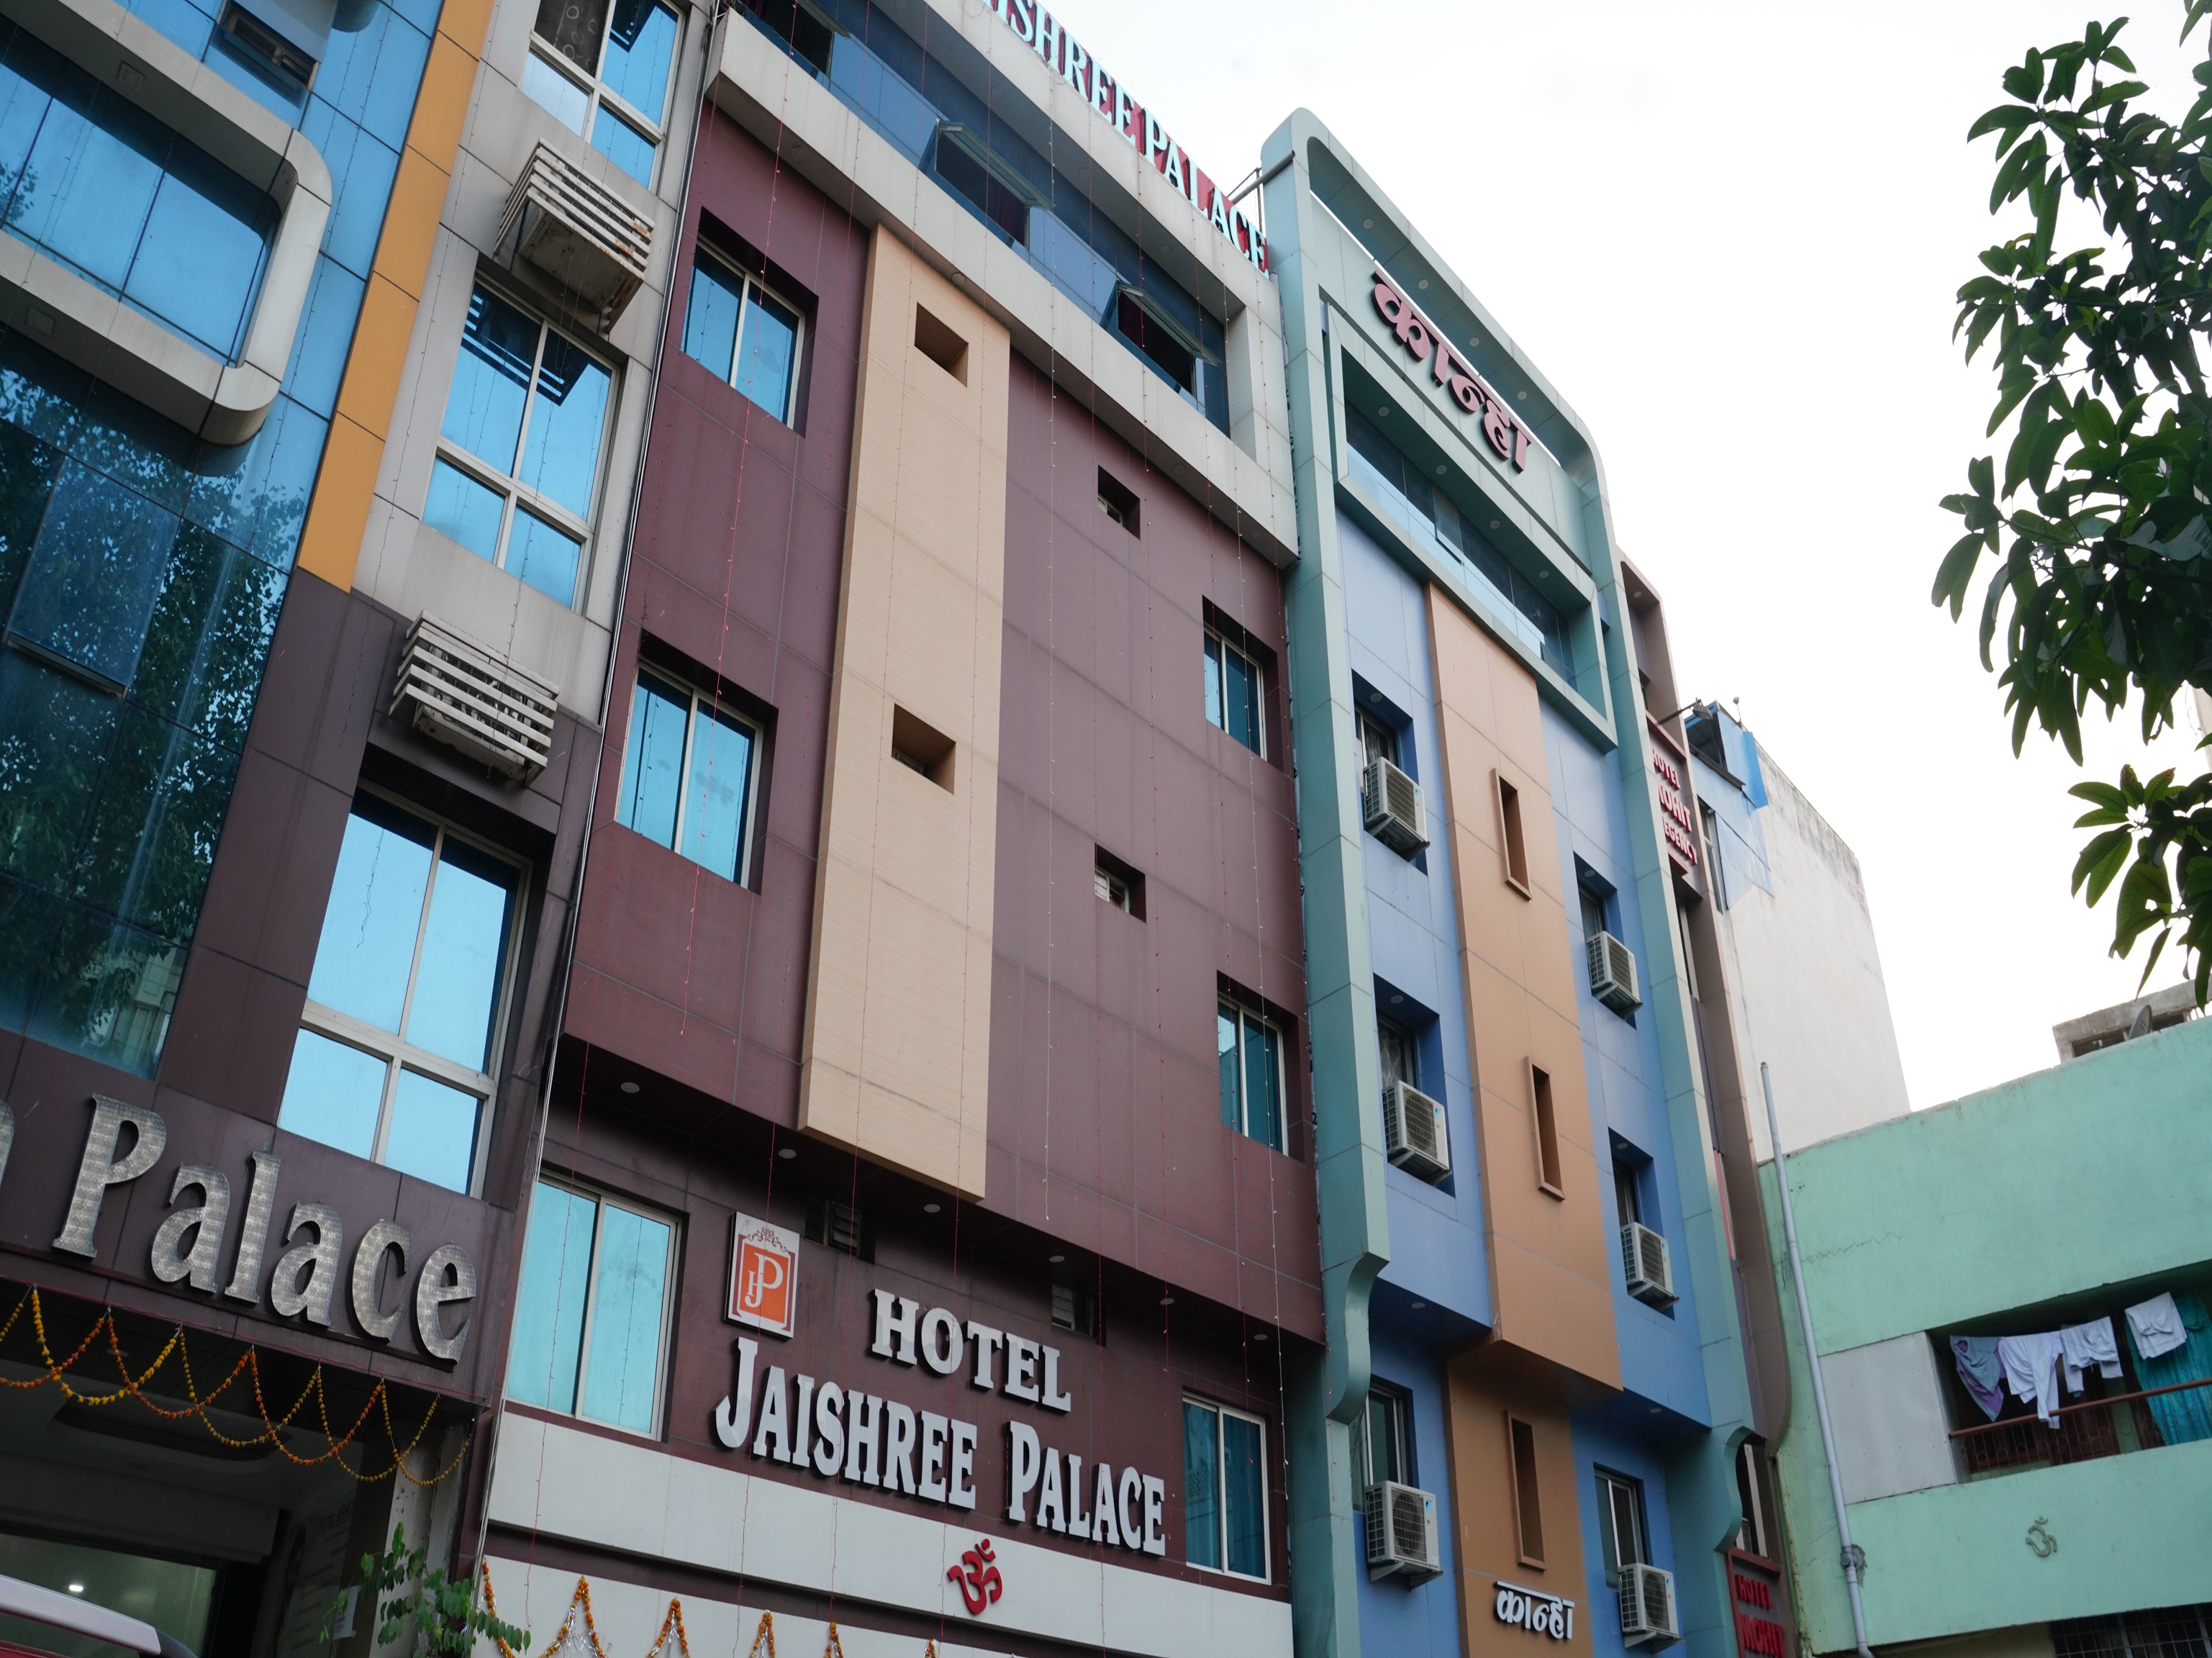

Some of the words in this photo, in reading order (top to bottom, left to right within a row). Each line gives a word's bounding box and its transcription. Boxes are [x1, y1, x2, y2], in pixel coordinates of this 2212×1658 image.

[1142, 107, 1269, 280] PALACE
[1662, 816, 1697, 865] EGENCY
[53, 1093, 477, 1365] Palace
[871, 1288, 1071, 1413] HOTEL
[715, 1336, 977, 1510] JAISHREE
[1008, 1420, 1166, 1556] PALACE
[1735, 1574, 1773, 1609] HOTEL
